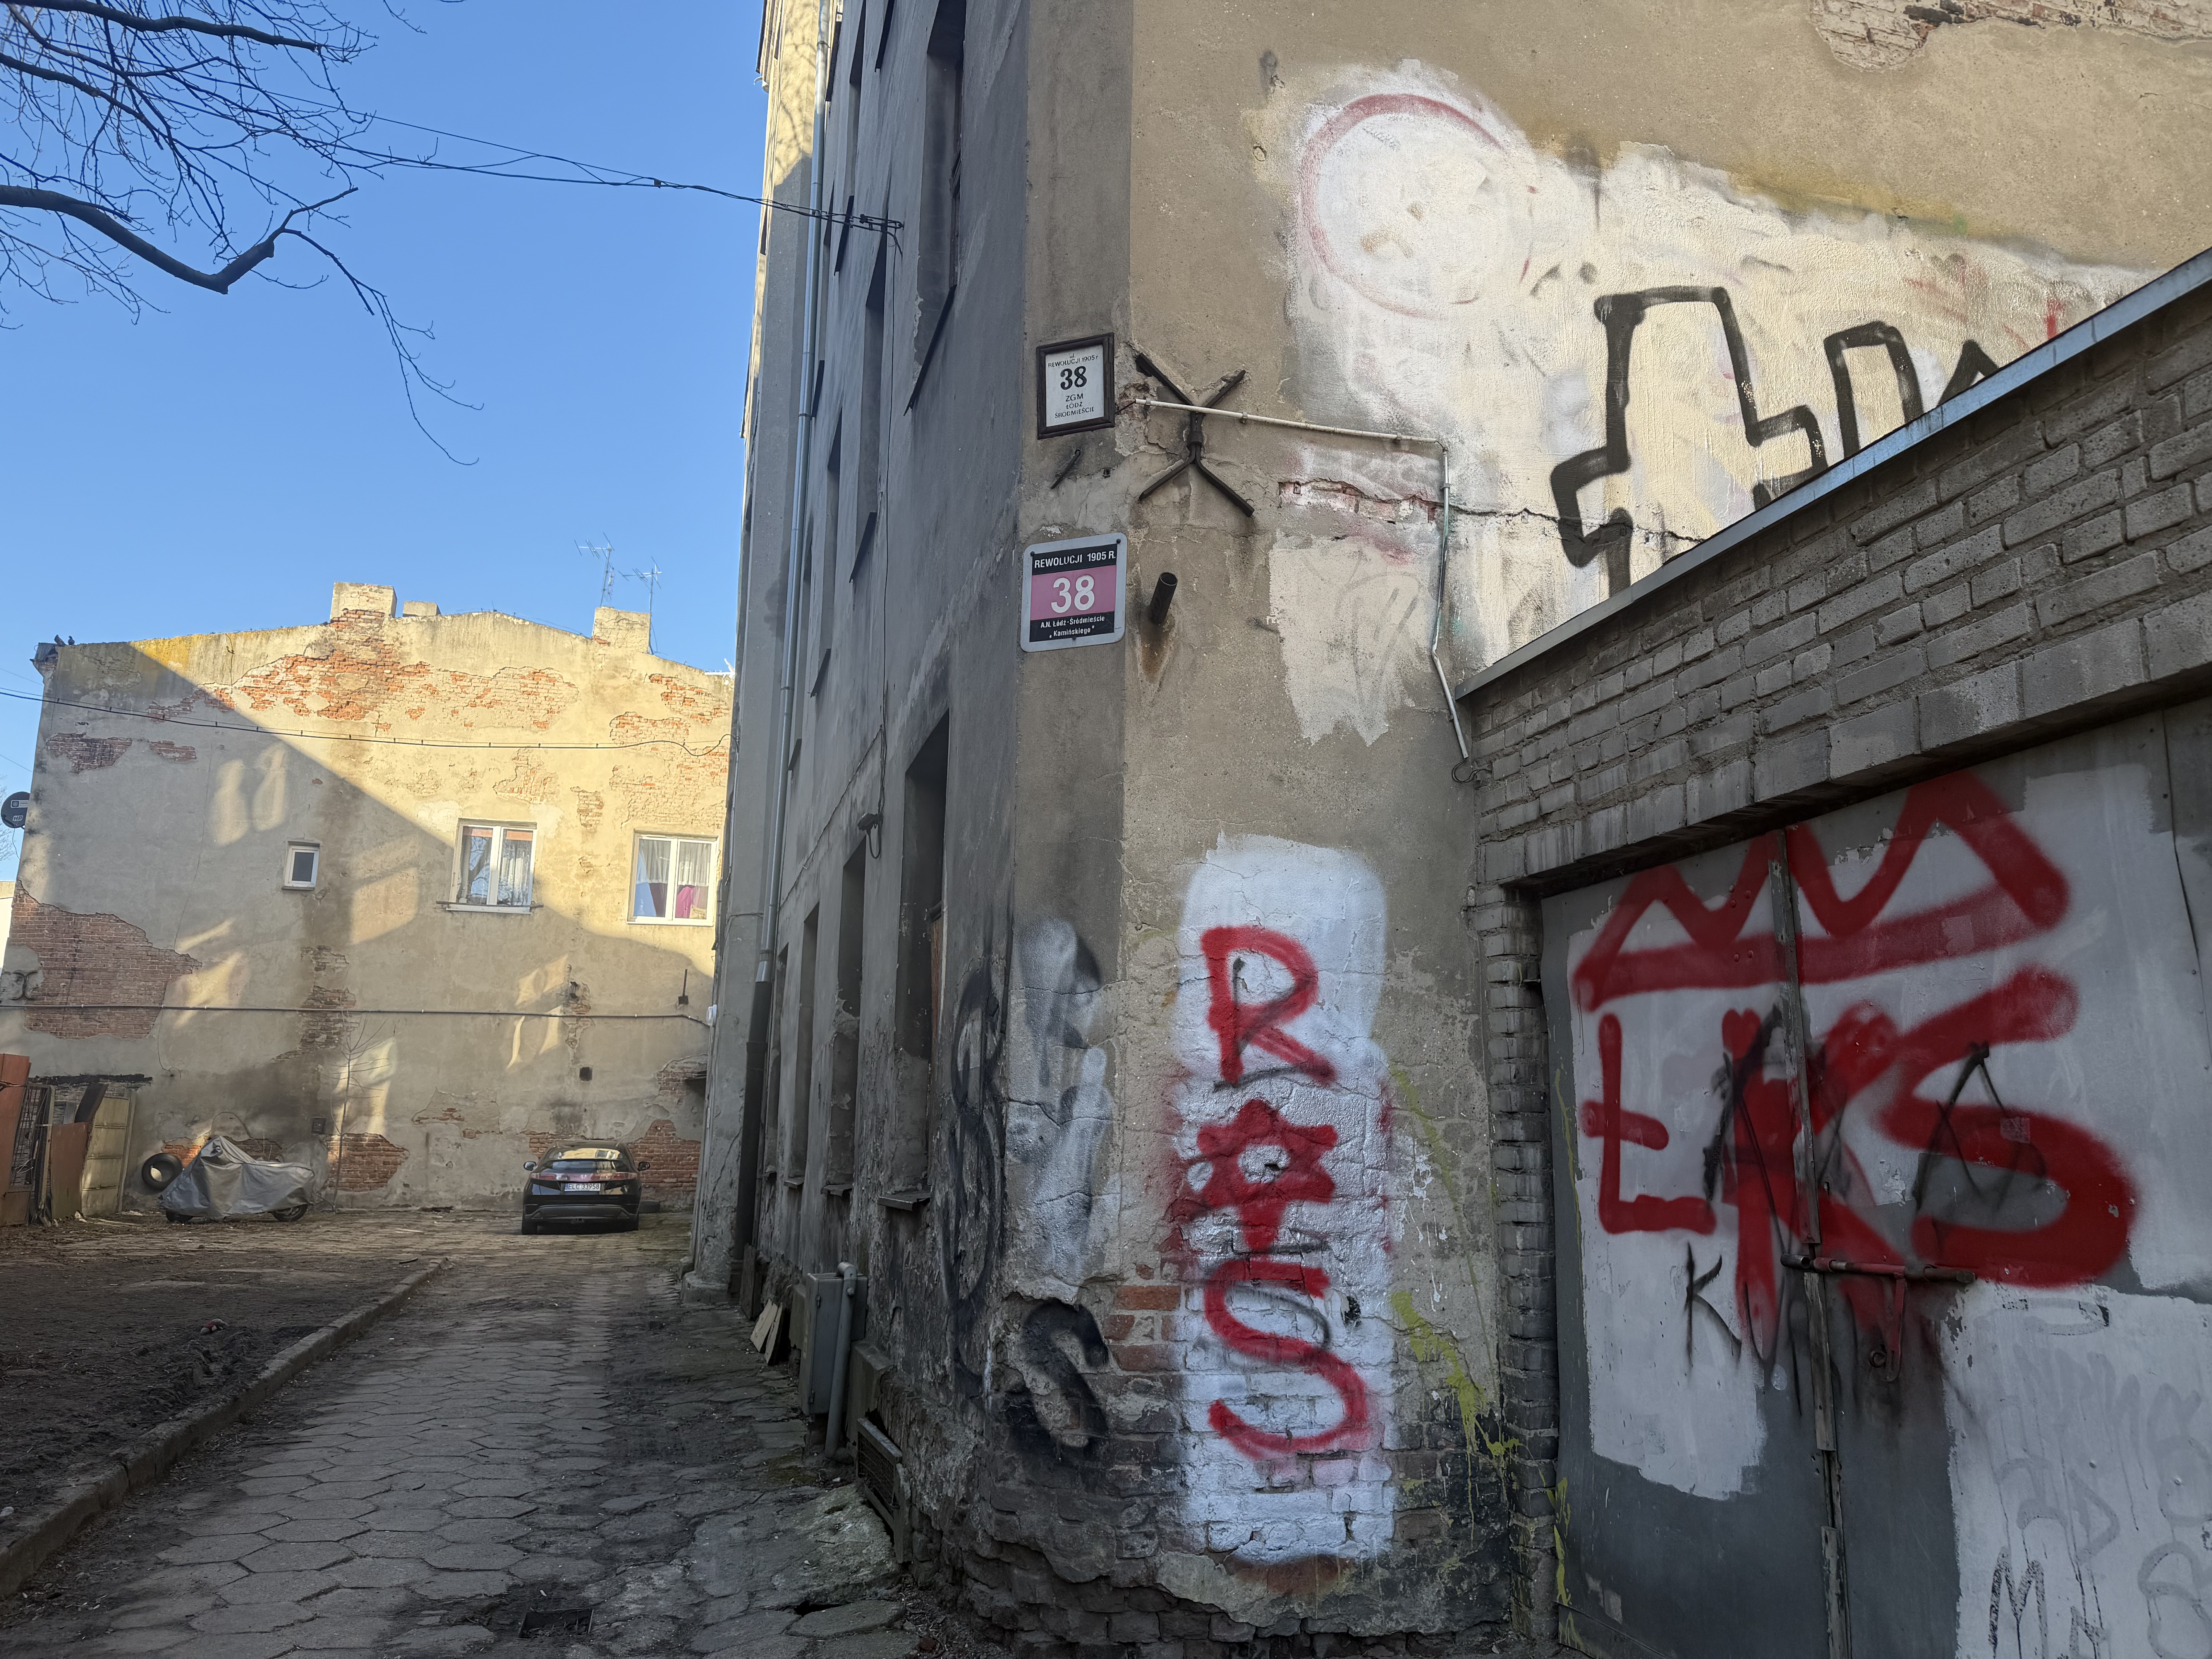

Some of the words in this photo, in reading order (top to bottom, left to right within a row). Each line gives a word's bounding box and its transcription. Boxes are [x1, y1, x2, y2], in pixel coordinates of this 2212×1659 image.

[1060, 366, 1087, 390] 38
[1065, 393, 1084, 402] ZGM
[1034, 554, 1082, 568] REWOLUCJI
[1087, 551, 1106, 562] 1905
[1108, 550, 1116, 560] R.
[1051, 575, 1095, 613] 38
